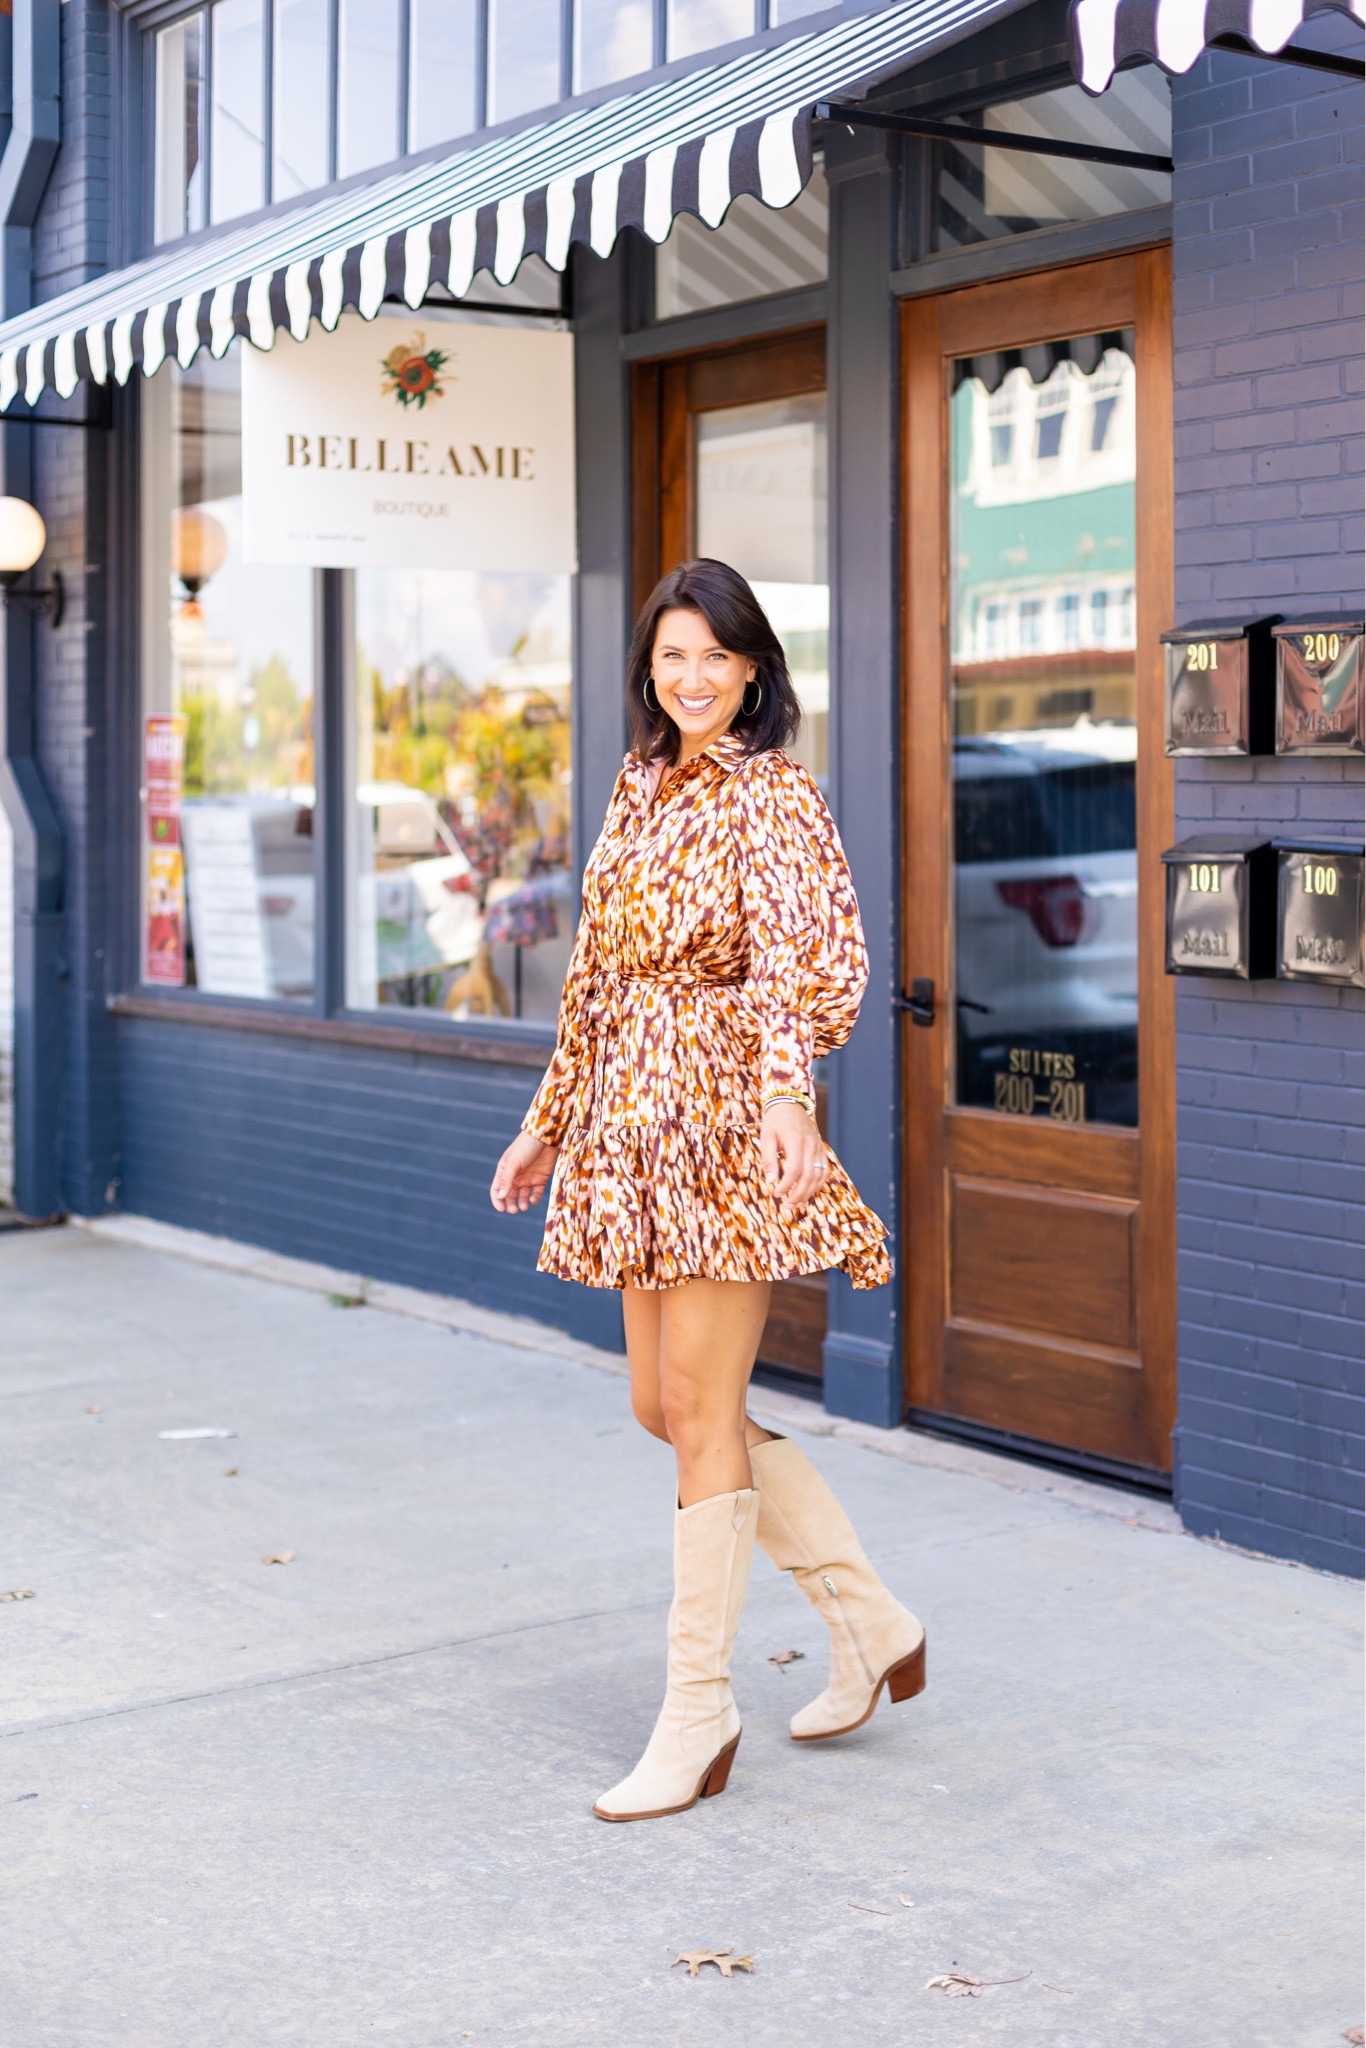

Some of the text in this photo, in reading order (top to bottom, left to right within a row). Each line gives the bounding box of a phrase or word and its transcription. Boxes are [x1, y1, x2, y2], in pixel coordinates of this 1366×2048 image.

[286, 433, 535, 480] BELLE AME
[372, 499, 450, 519] BOUTIQUE
[1187, 643, 1218, 671] 201
[1303, 633, 1339, 661] 200
[1182, 711, 1228, 733] Mail
[1296, 710, 1345, 733] Mail
[1189, 864, 1220, 893] 101
[1303, 865, 1337, 895] 100
[1181, 932, 1230, 956] Mail
[1009, 1048, 1075, 1078] SUITES
[995, 1072, 1086, 1123] 200-201
